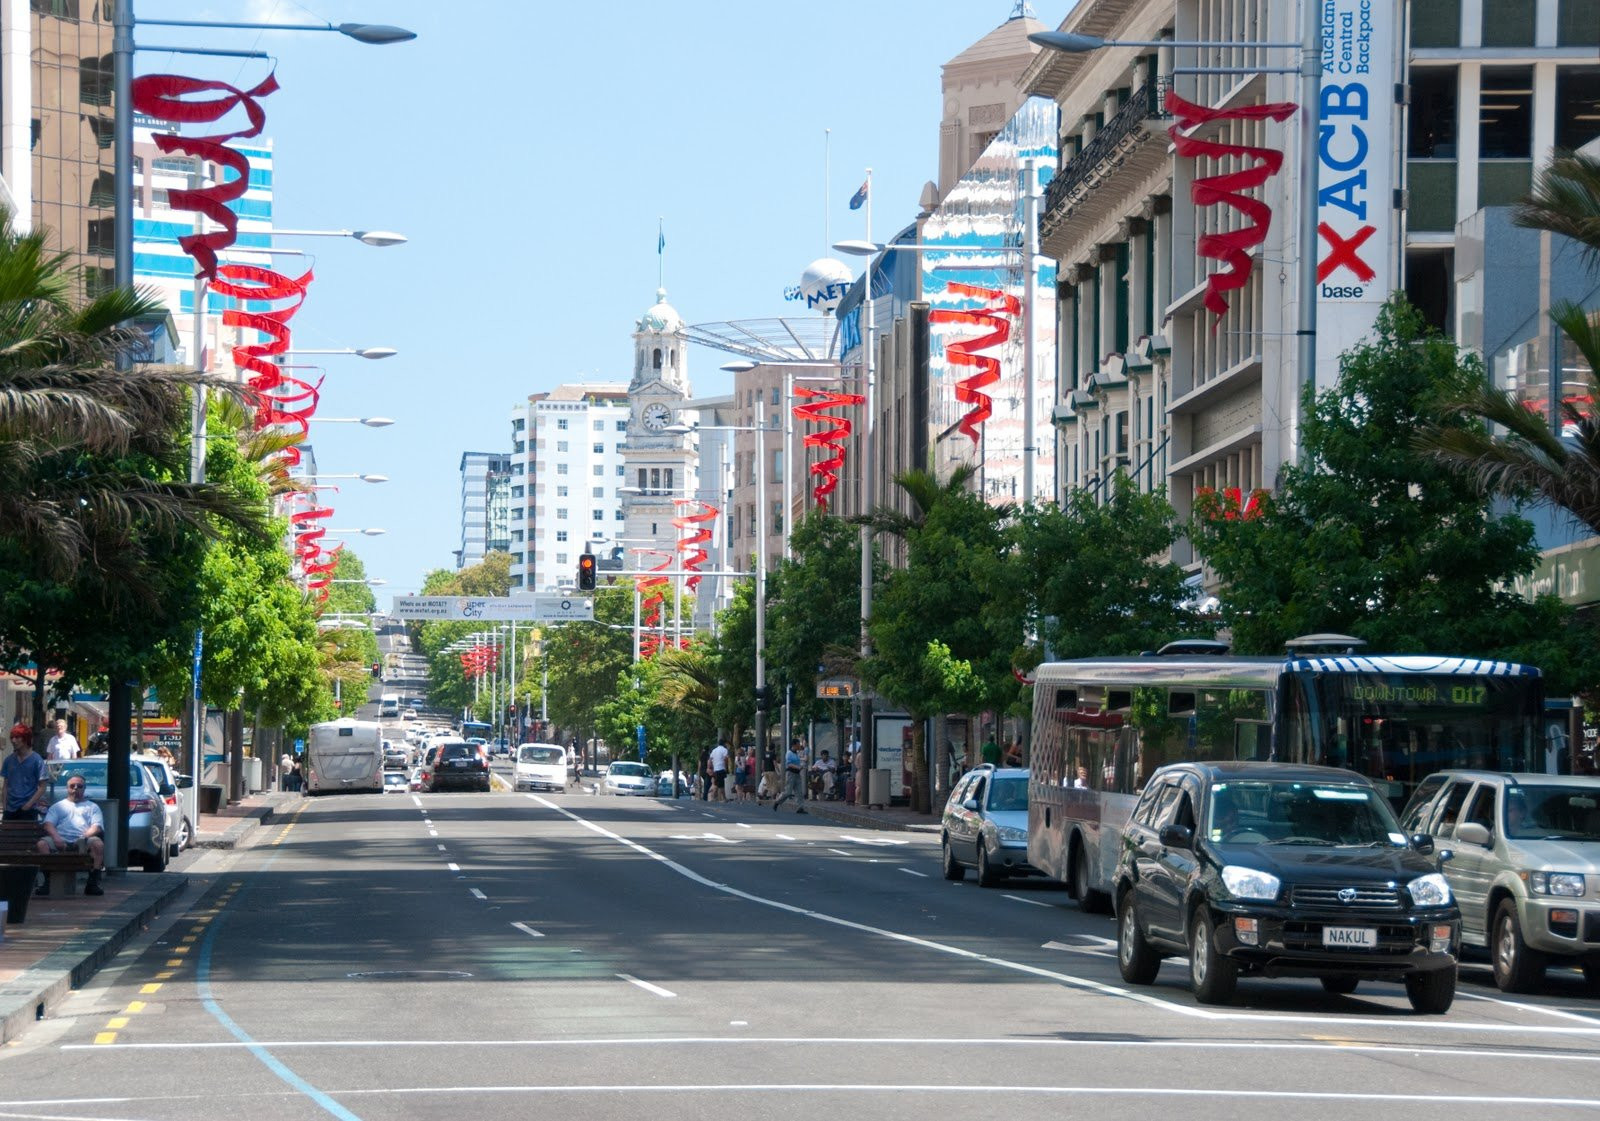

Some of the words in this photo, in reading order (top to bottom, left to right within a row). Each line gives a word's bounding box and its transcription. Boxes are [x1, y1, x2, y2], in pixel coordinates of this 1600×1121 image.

[1321, 0, 1335, 74] Aucklan
[1338, 11, 1353, 74] Central
[1318, 82, 1369, 221] ACB
[1322, 283, 1364, 298] base
[463, 607, 483, 618] City
[1354, 686, 1437, 701] DOWNTOWN
[1329, 930, 1370, 944] NAKUL
